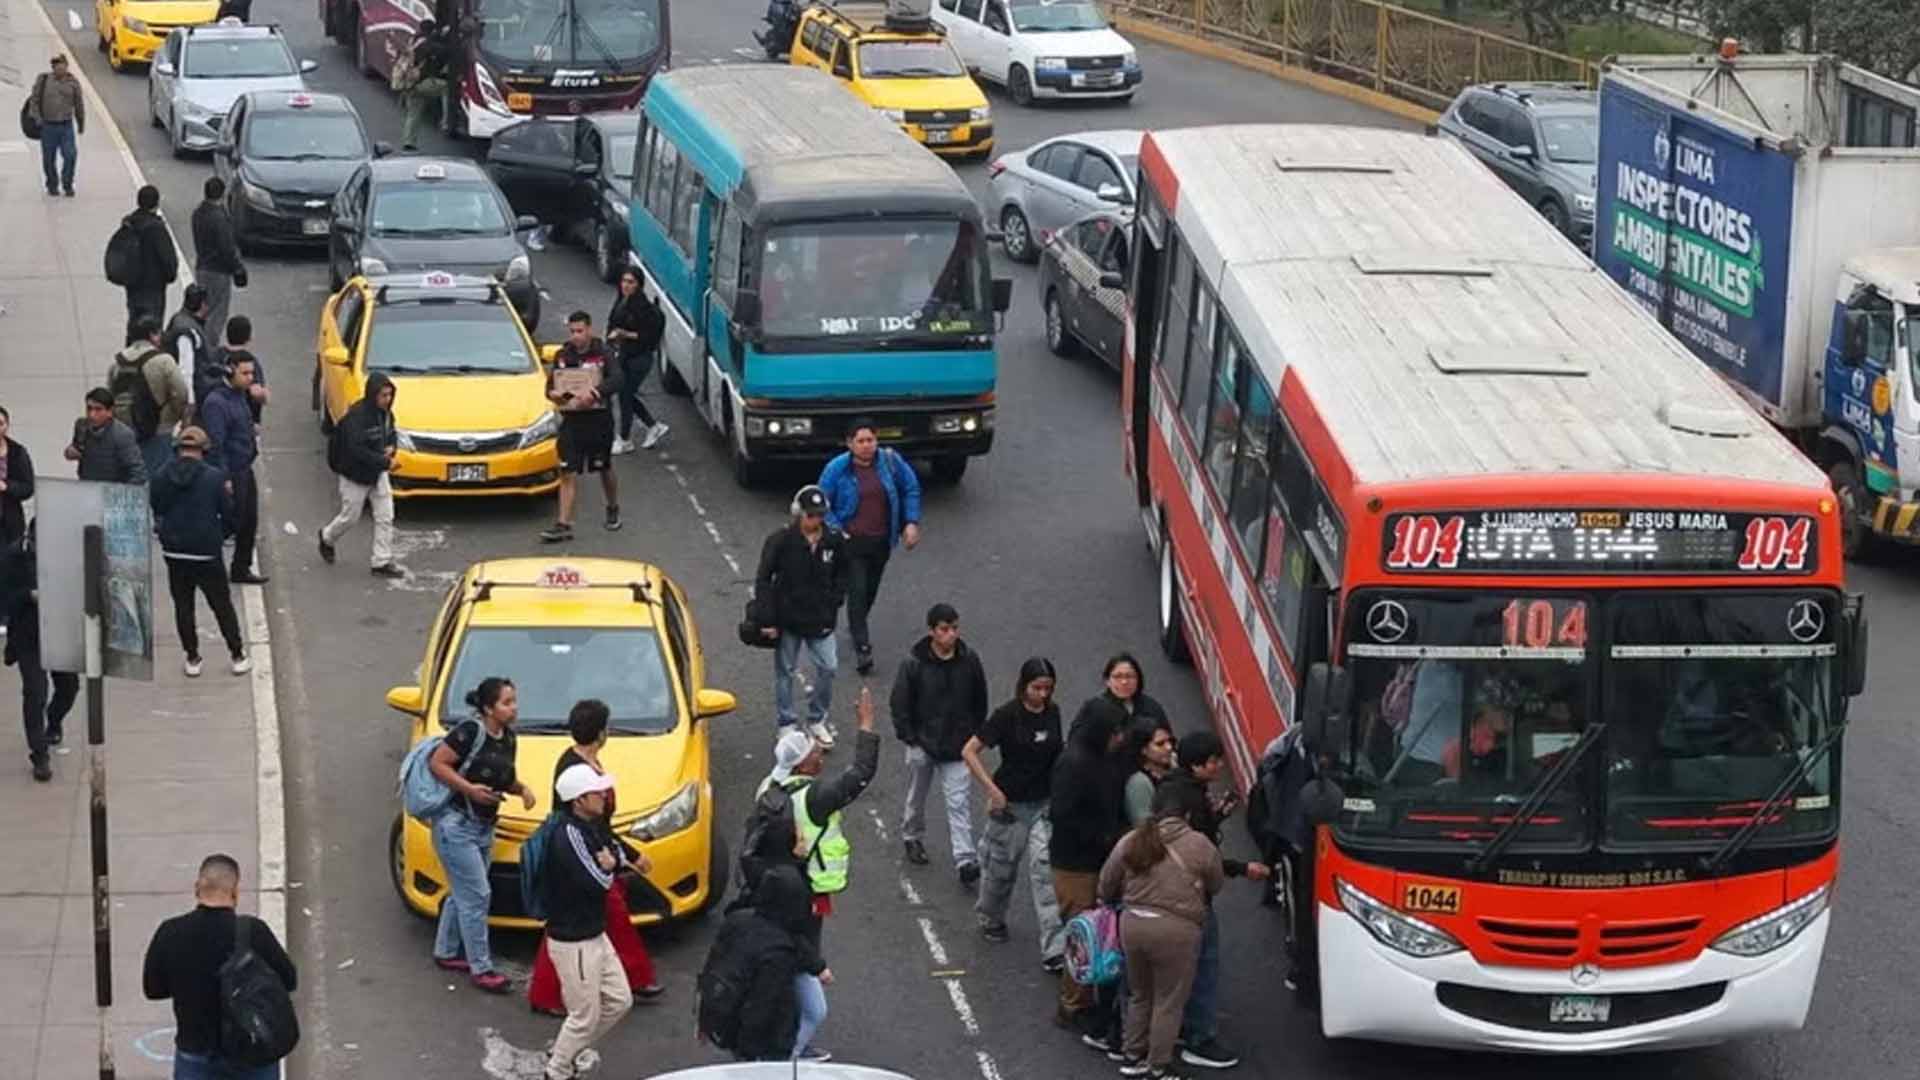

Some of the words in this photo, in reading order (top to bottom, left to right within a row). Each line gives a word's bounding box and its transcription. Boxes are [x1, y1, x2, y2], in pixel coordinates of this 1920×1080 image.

[1675, 144, 1715, 185] LIMA
[1617, 161, 1751, 254] INSPECTORES
[1614, 212, 1751, 307] AMBIENTALES
[1387, 515, 1465, 569] 104
[1625, 512, 1675, 529] JESUS
[1679, 513, 1728, 529] MARIA
[1573, 527, 1660, 560] 1044
[1738, 517, 1811, 570] 104
[545, 571, 580, 585] TAXI
[1502, 599, 1587, 648] 104
[1407, 886, 1458, 910] 1044
